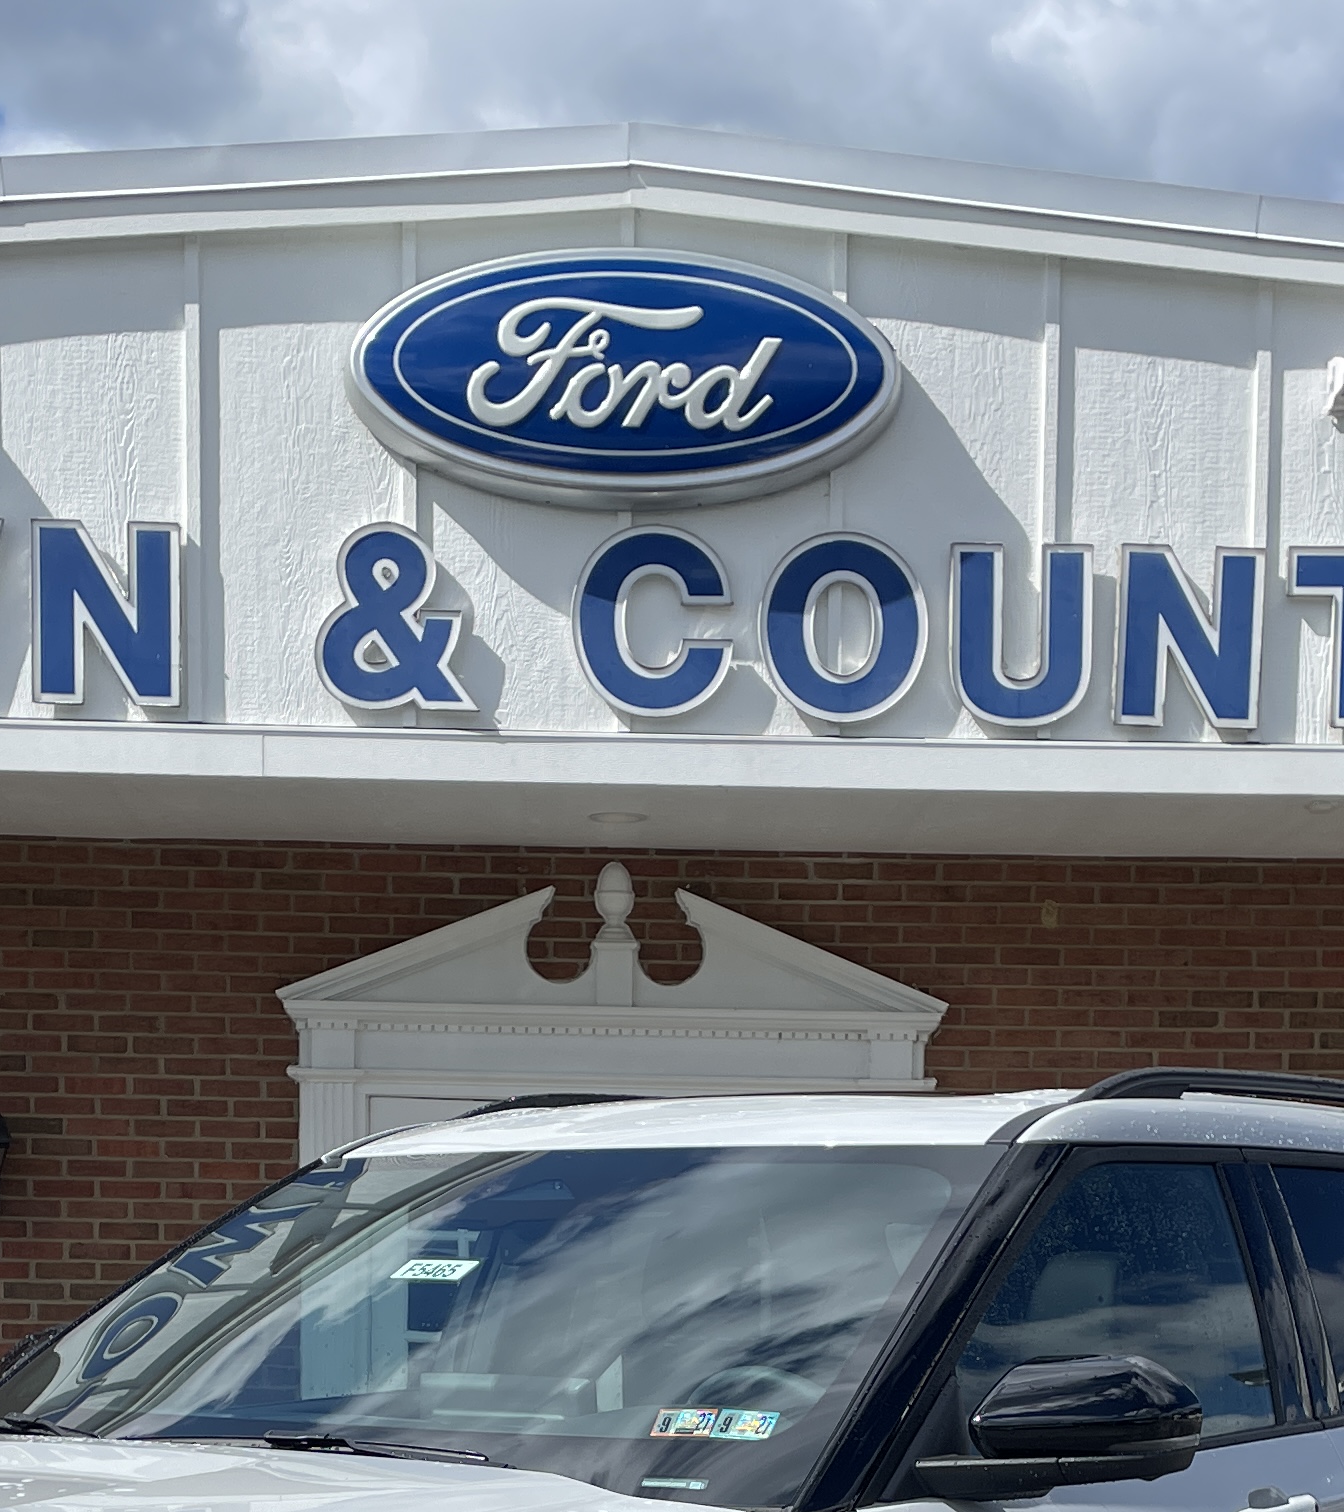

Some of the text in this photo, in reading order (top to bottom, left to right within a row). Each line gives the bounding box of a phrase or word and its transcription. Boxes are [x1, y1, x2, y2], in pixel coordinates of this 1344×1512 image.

[465, 296, 784, 432] Ford
[316, 522, 479, 712] &
[399, 1262, 463, 1278] F5465
